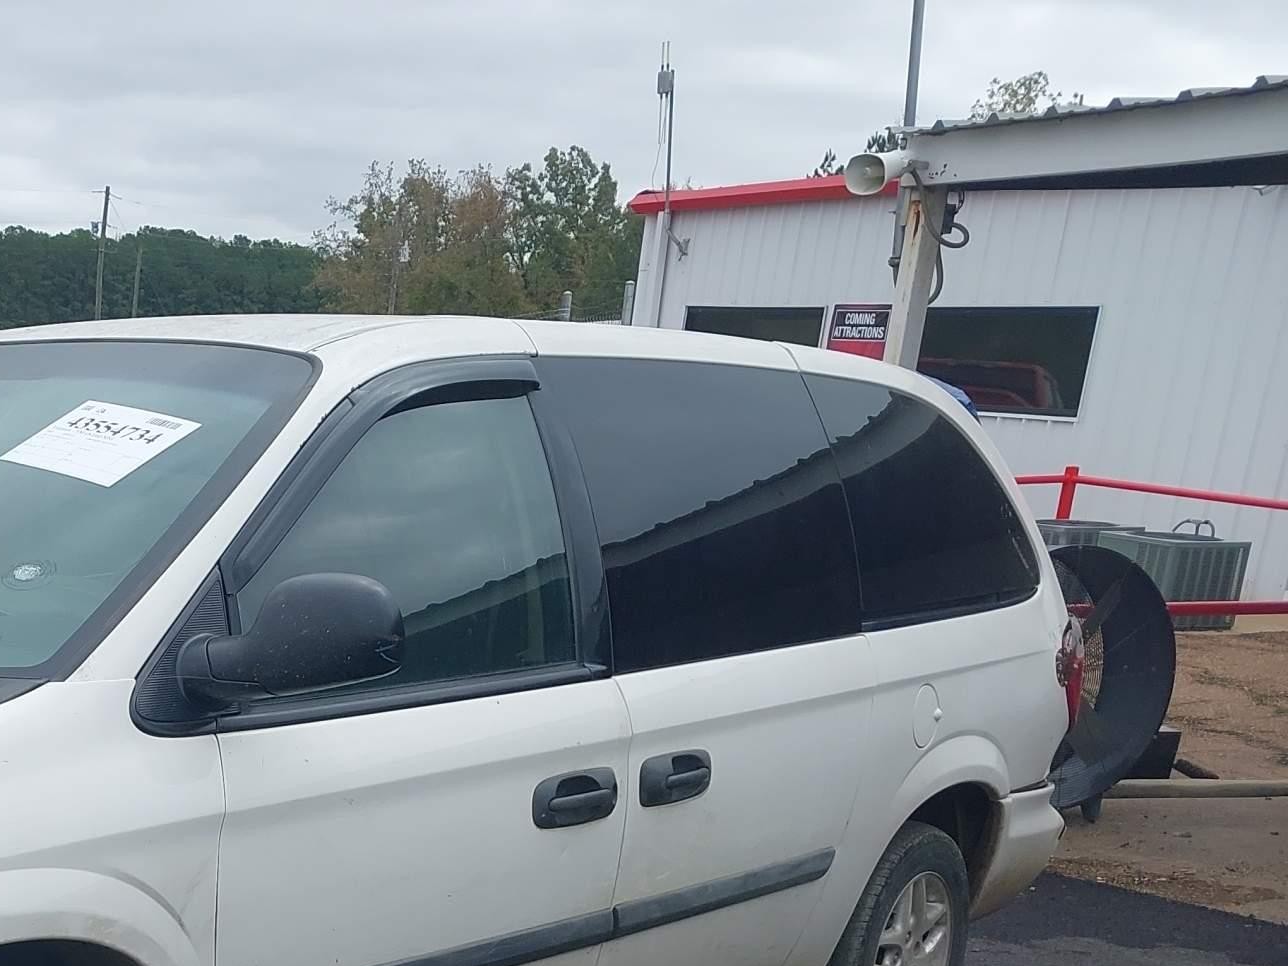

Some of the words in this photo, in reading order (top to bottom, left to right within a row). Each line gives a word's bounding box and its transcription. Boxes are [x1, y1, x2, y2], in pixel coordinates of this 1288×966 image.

[844, 312, 876, 325] COMING
[833, 326, 885, 339] ATTRACTIONS
[67, 416, 164, 445] 43554734
